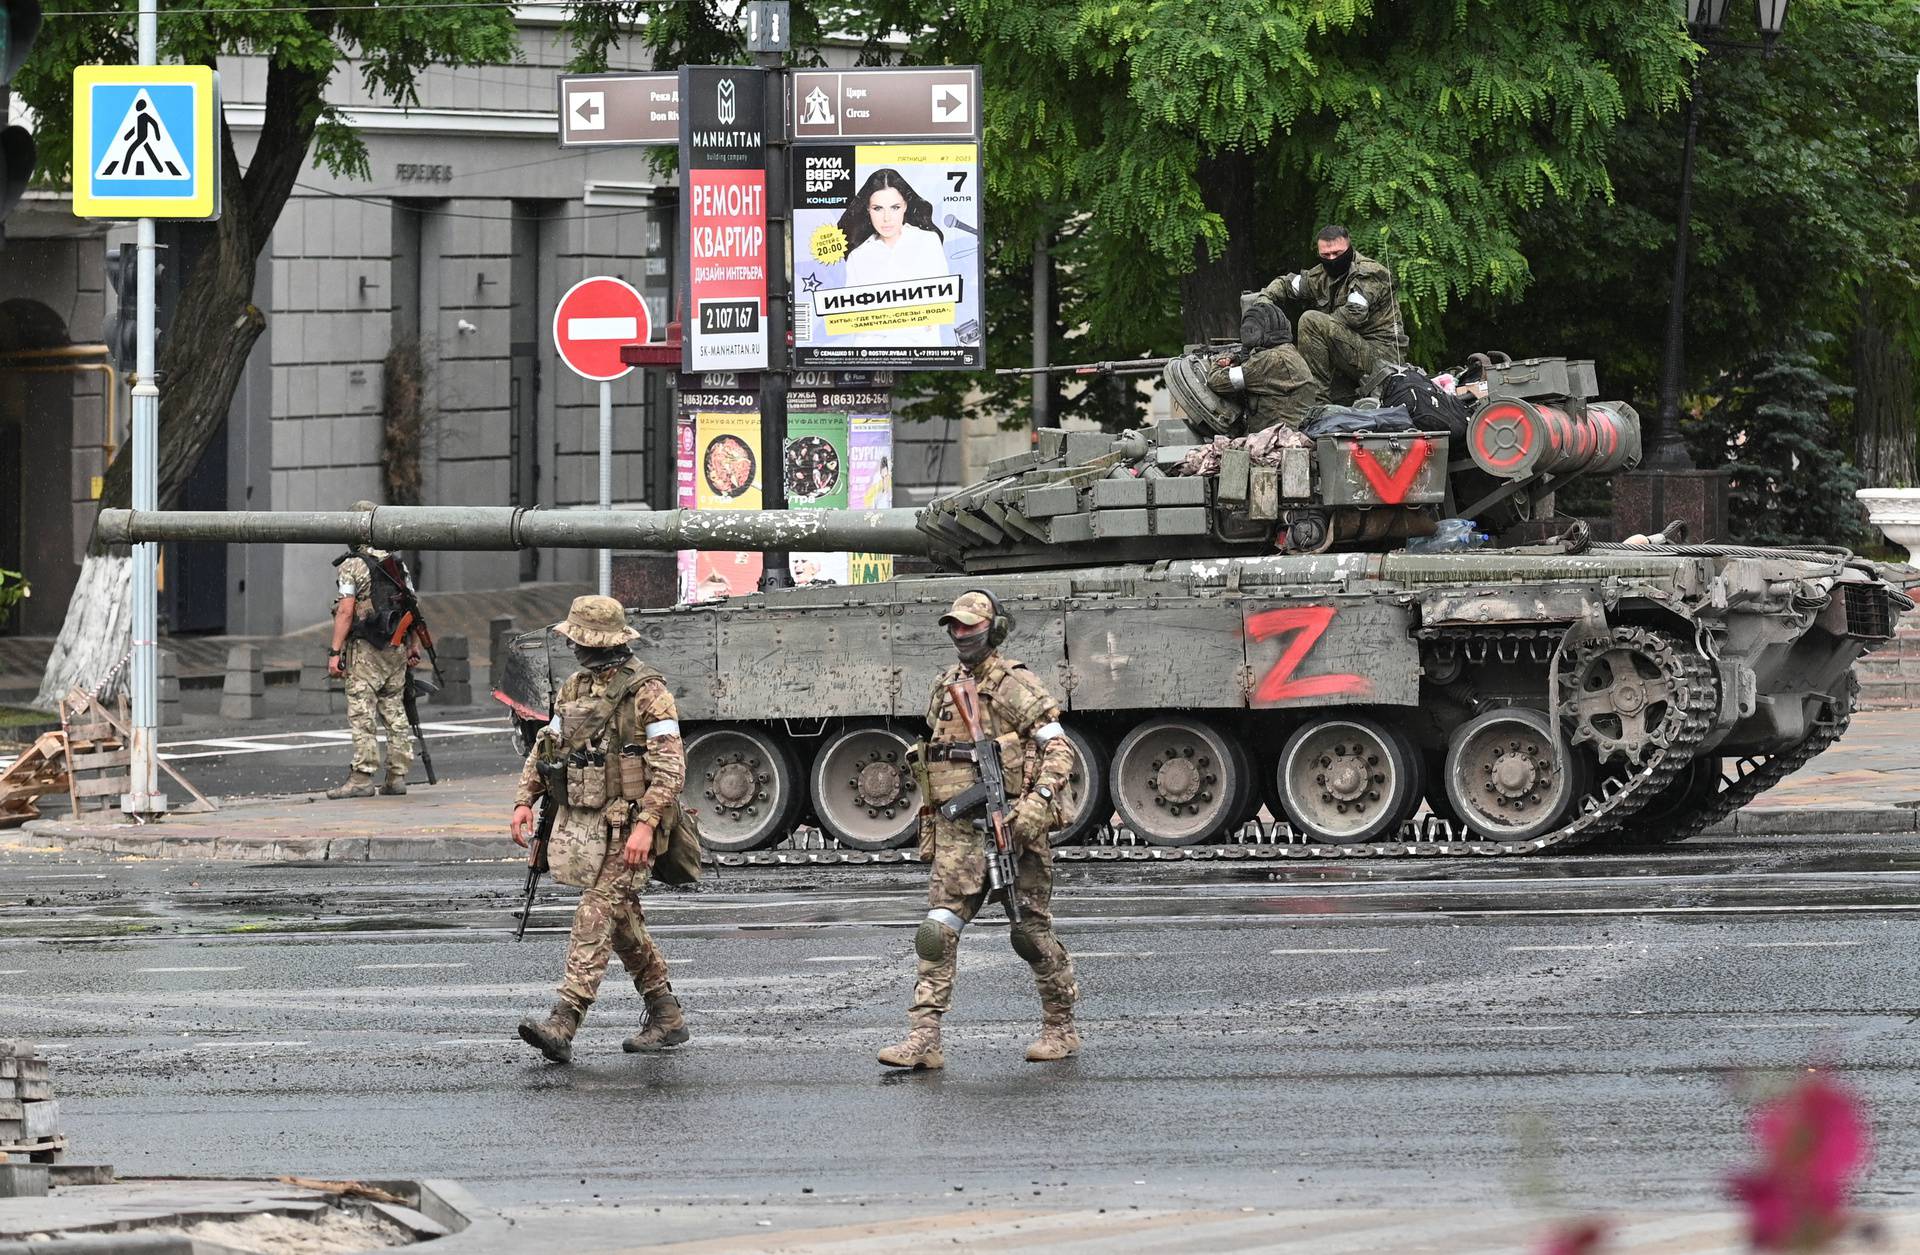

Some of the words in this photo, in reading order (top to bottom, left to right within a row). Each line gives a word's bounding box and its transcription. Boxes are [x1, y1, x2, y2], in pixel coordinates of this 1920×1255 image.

[650, 91, 670, 102] Река
[846, 87, 867, 99] Цирк
[650, 112, 667, 121] Don
[846, 108, 870, 118] Circus
[692, 131, 761, 148] MANHATTAN
[805, 157, 842, 169] РУКИ
[805, 181, 834, 192] БАР
[946, 171, 967, 192] 7
[693, 184, 762, 216] РЕМОНТ
[693, 226, 763, 258] КВАРТИР
[816, 242, 842, 257] 20:00
[695, 264, 725, 284] ДИЗАЙН
[726, 265, 763, 281] ИНТЕРЬЕРА
[824, 283, 953, 309] ИНФИНИТИ
[700, 343, 760, 357] SK-MANHATTAN.RU
[704, 373, 736, 387] 40/2
[795, 371, 831, 386] 40/1
[1347, 435, 1436, 505] V
[1246, 605, 1373, 702] Z
